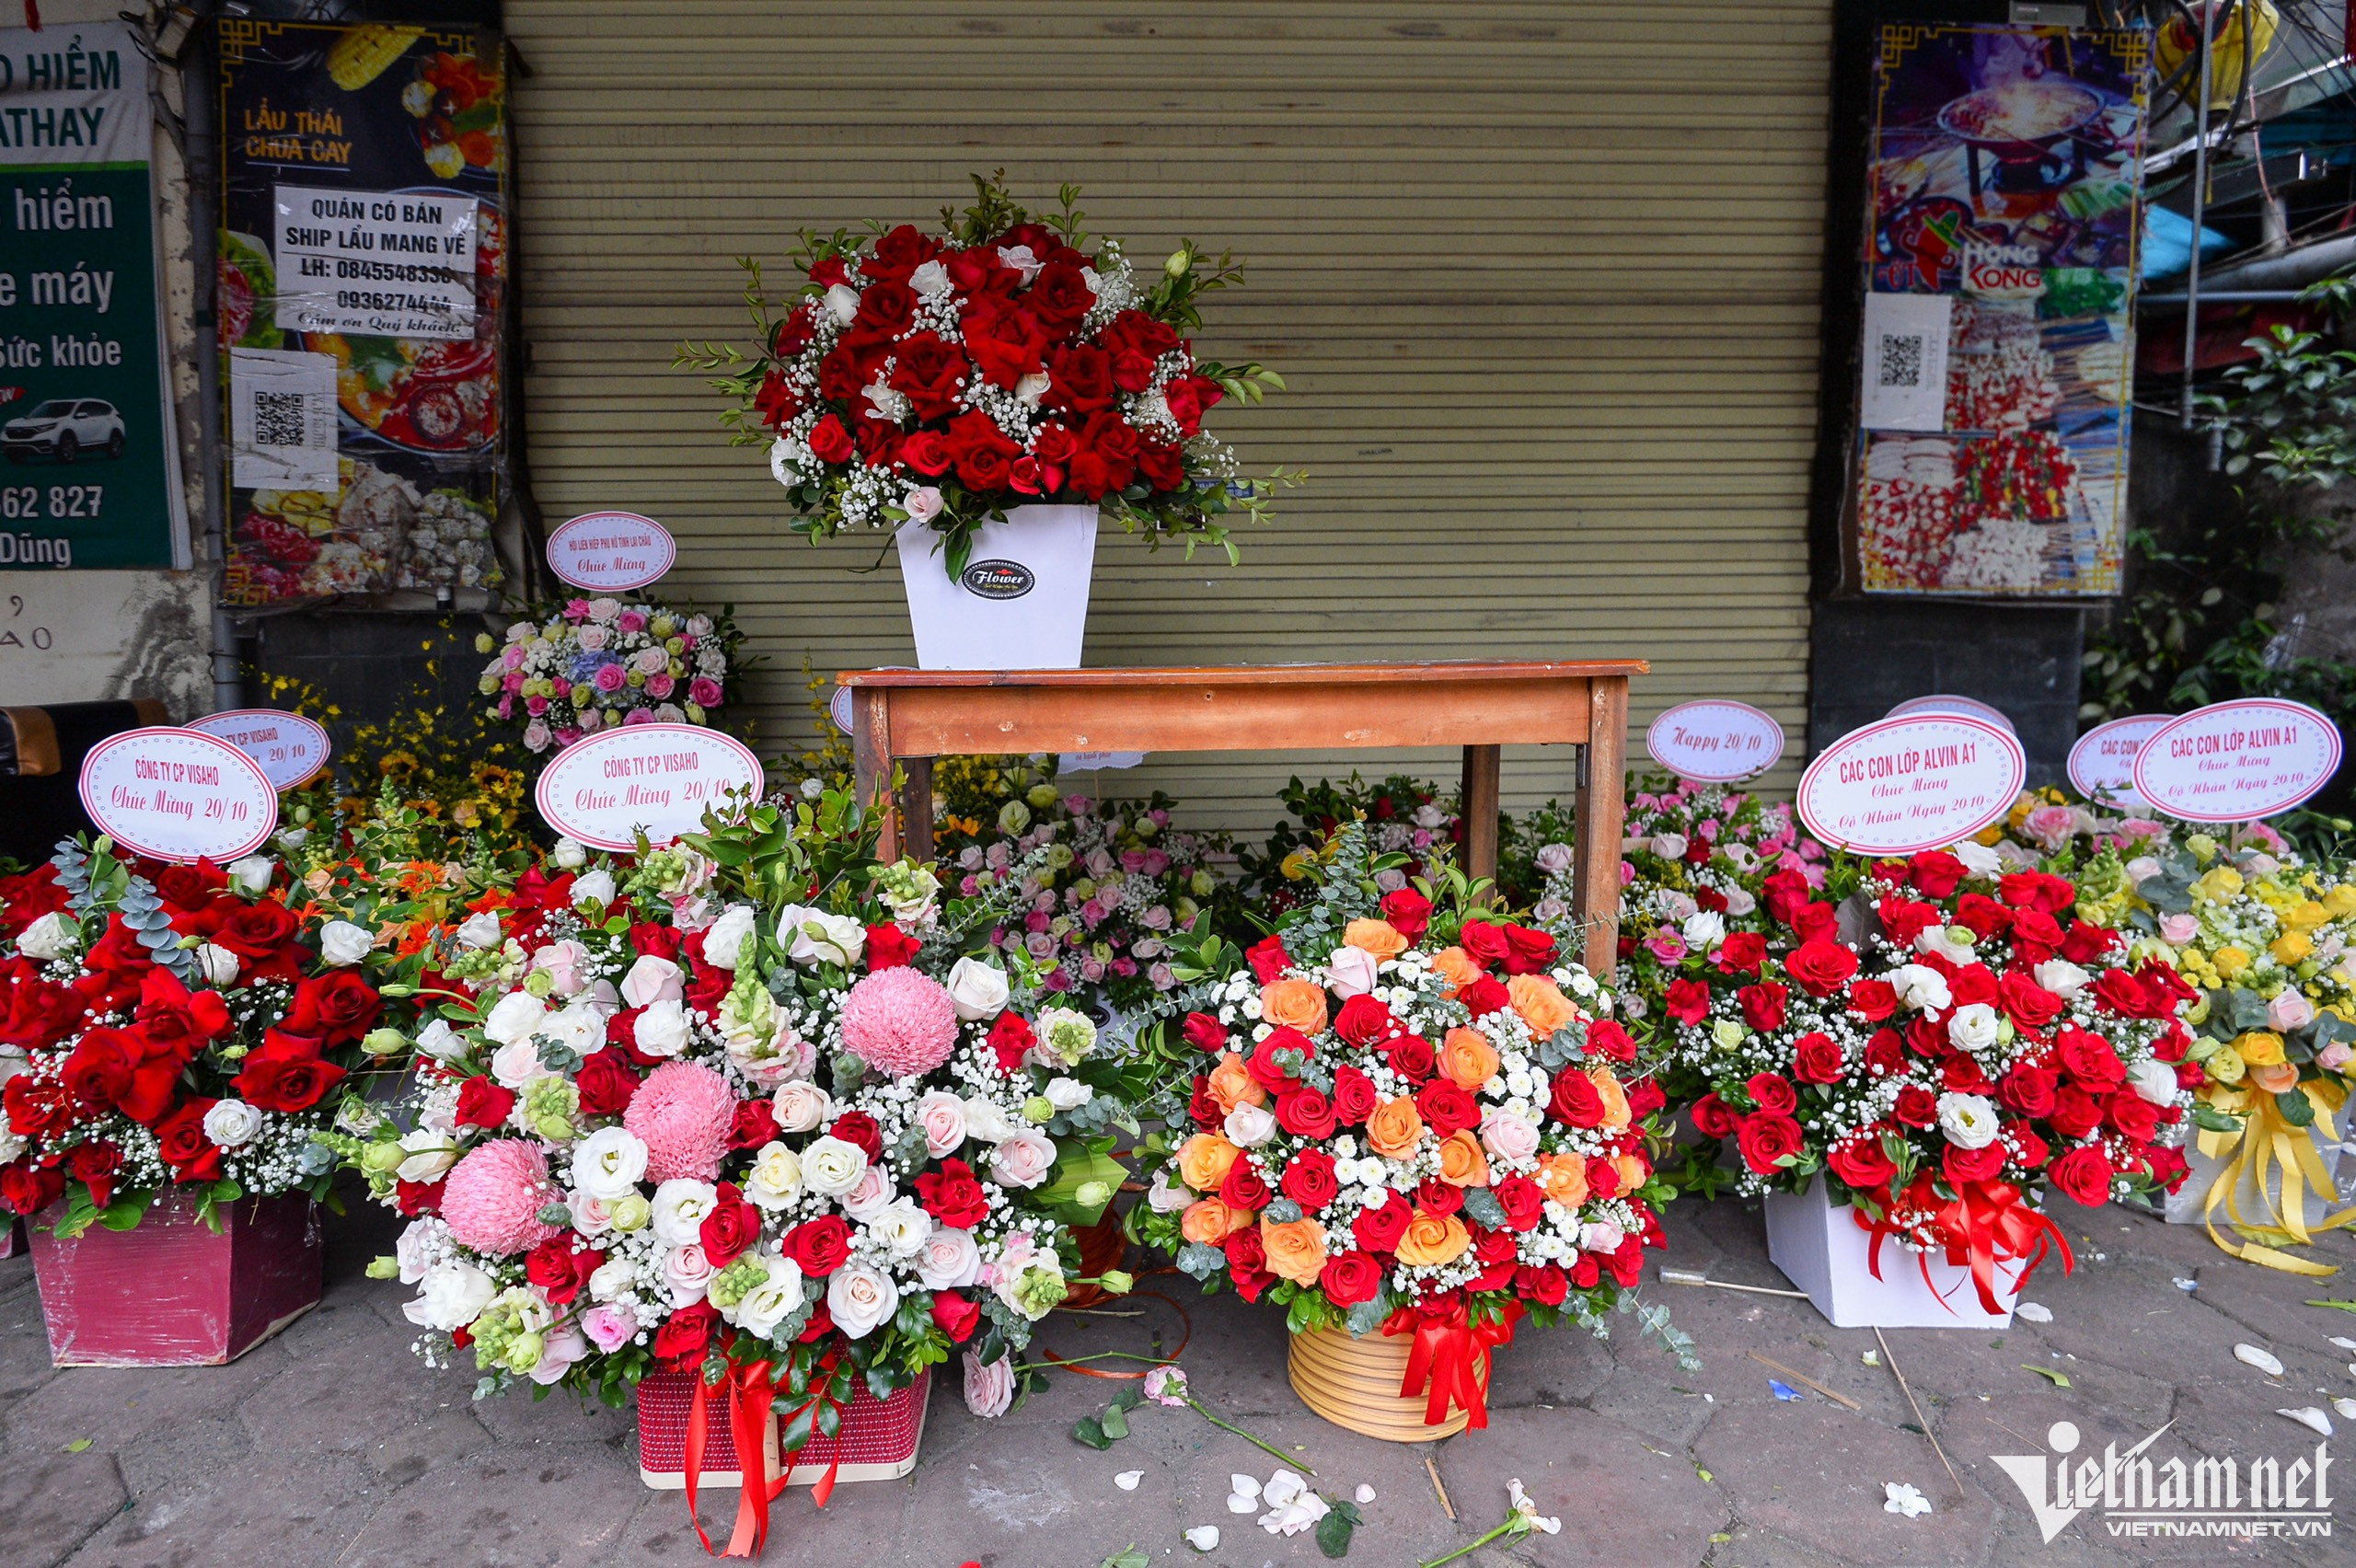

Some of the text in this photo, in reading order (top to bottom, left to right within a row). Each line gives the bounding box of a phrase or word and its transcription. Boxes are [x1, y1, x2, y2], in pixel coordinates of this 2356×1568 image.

[27, 34, 121, 90] HIỂM
[294, 107, 343, 137] THÁI
[245, 135, 352, 164] CHUA CAY
[16, 178, 113, 230] hiểm
[312, 196, 443, 225] QUÁN CÓ BÁN
[285, 224, 467, 255] SHIP LẨU MANG VỀ
[1963, 240, 2040, 268] HONG
[300, 258, 331, 277] LH:
[1968, 263, 2041, 291] KONG
[31, 261, 113, 314] máy
[52, 332, 122, 367] khỏe
[49, 484, 104, 517] 827
[0, 532, 72, 568] Dũng
[578, 557, 646, 572] Chúc Mừng
[972, 570, 1024, 584] Flower
[249, 727, 279, 744] VISAHO
[1671, 726, 1720, 752] Happy
[2171, 725, 2297, 758] CÁC CON LỚP ALVIN A1
[135, 755, 220, 787] CÔNG TY CP VISAHO
[604, 751, 699, 779] CÔNG TY CP VISAHO
[1840, 741, 1976, 783] CÁC CON LỚP ALVIN A1
[2199, 759, 2229, 772] Chúc
[111, 784, 147, 809] Chúc
[150, 789, 195, 821] Mừng
[575, 787, 617, 812] Chúc
[621, 783, 671, 808] Mừng
[1871, 777, 1949, 799] Chúc Mừng
